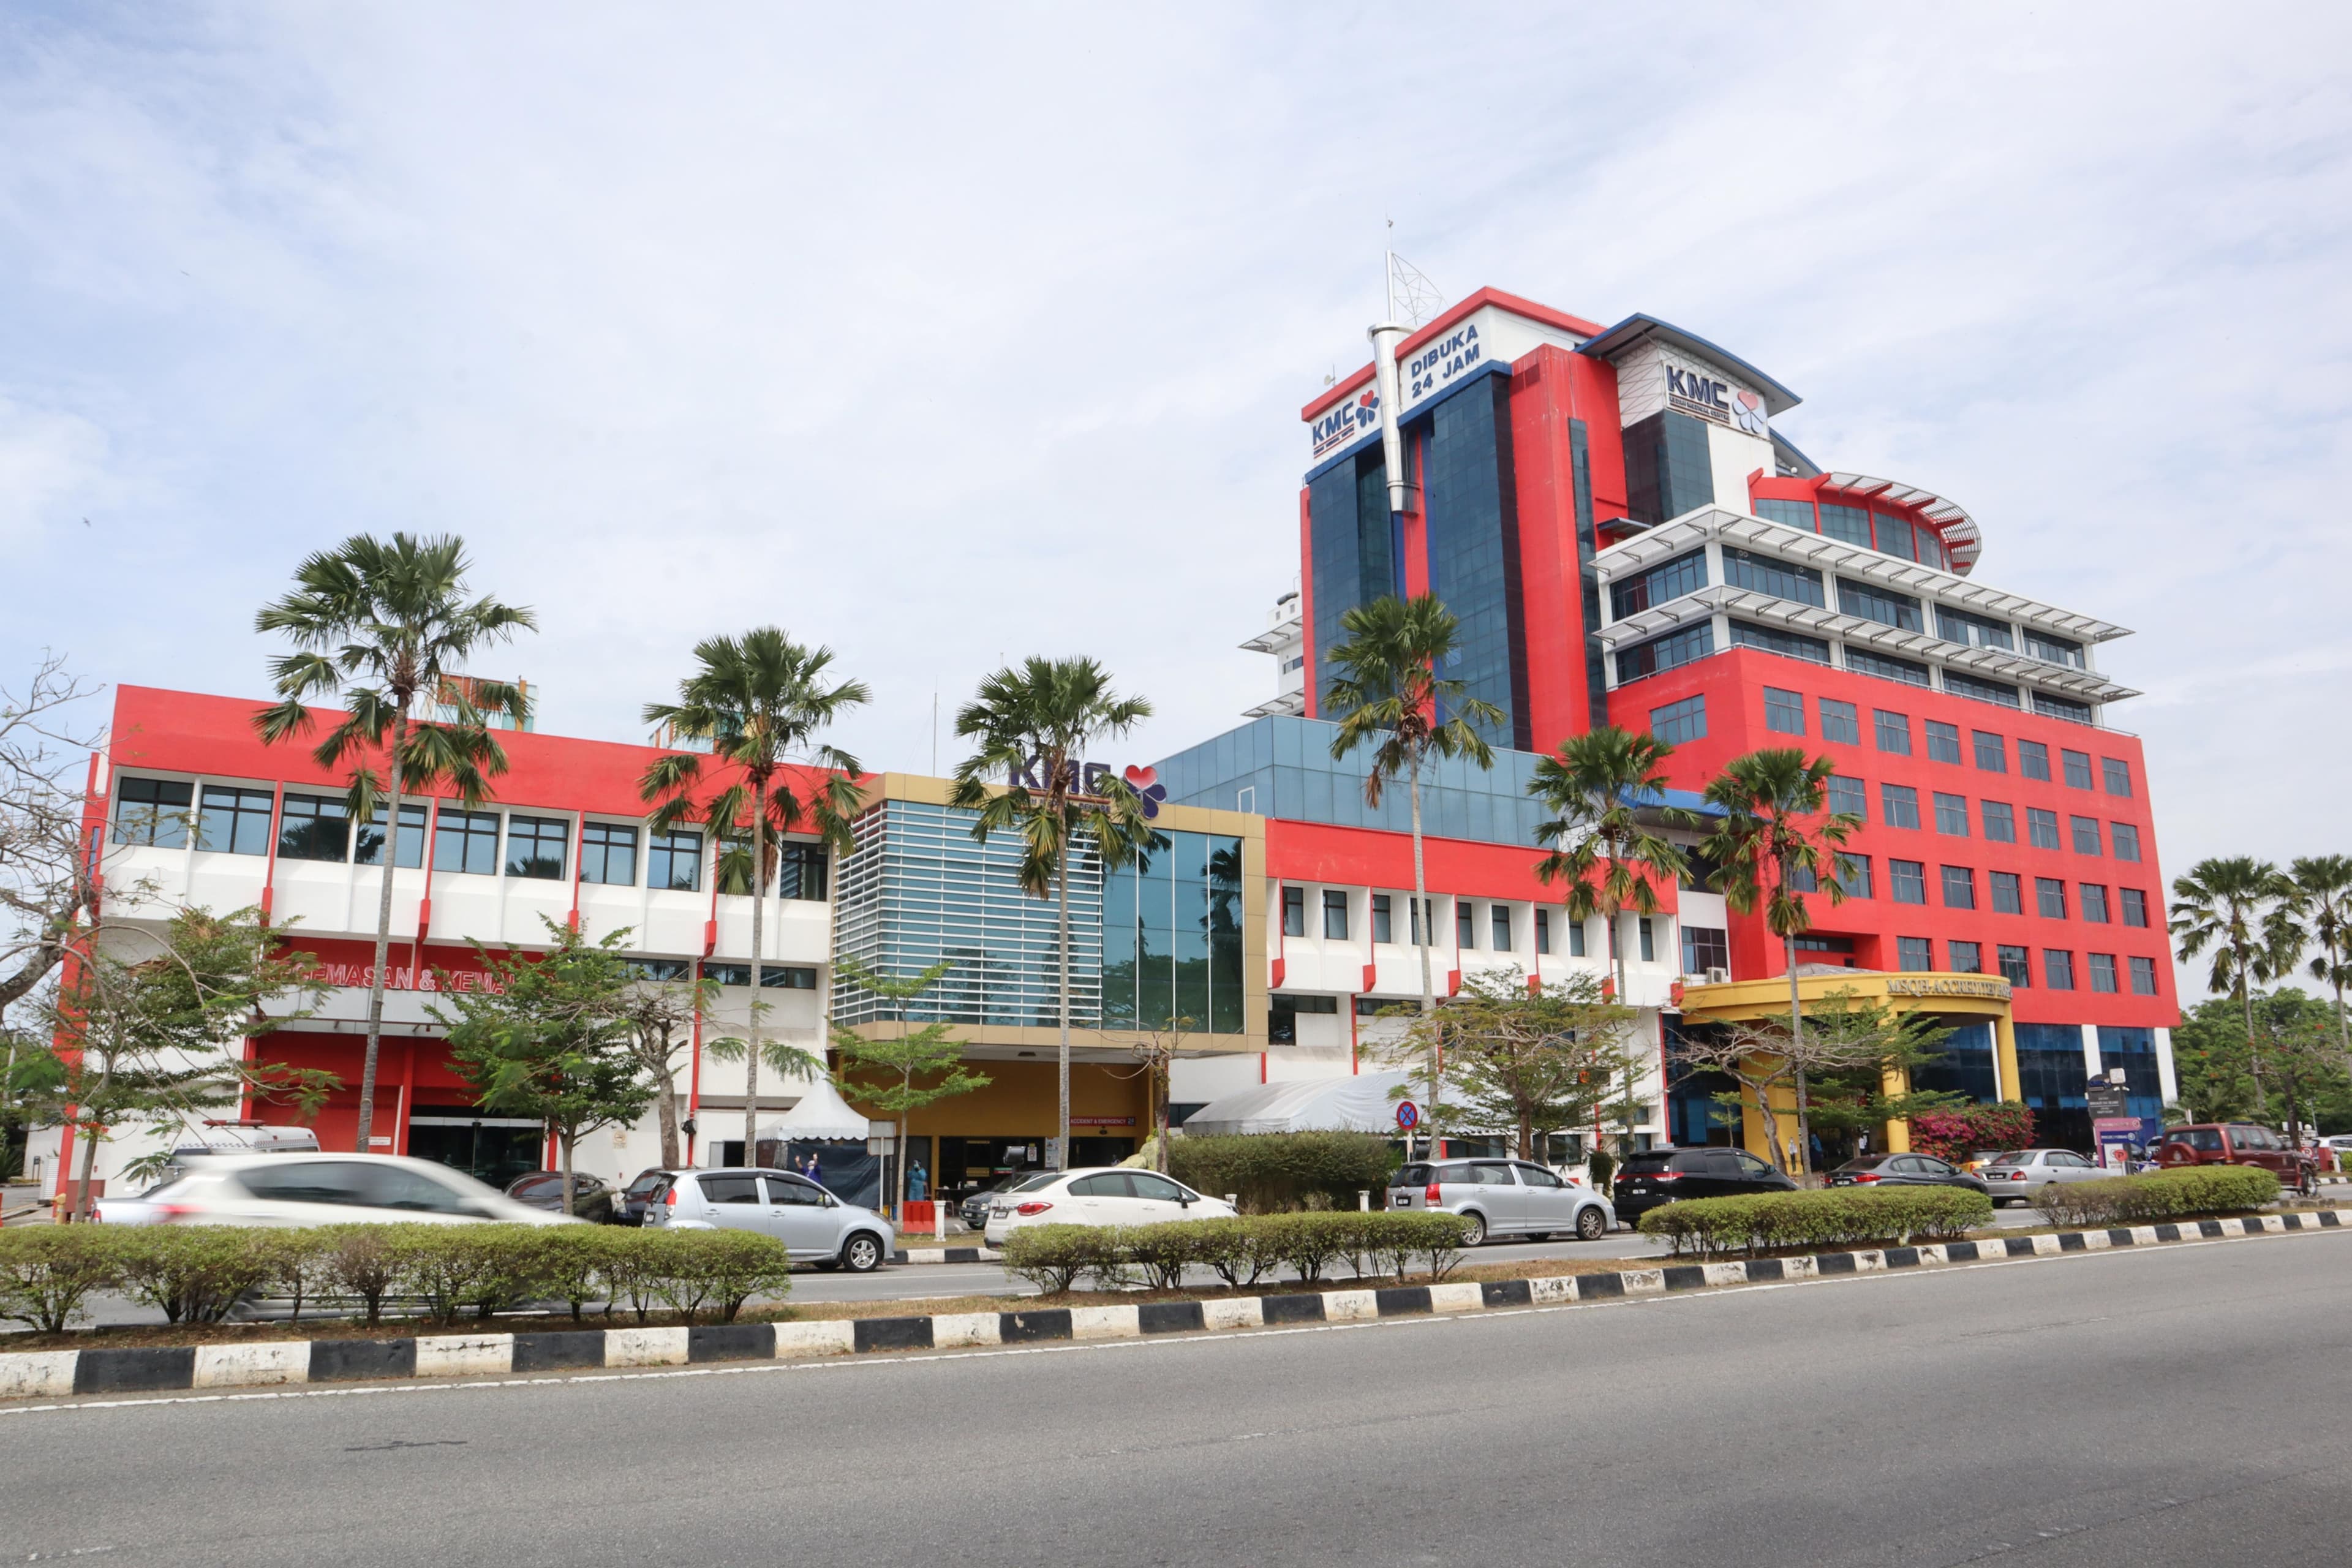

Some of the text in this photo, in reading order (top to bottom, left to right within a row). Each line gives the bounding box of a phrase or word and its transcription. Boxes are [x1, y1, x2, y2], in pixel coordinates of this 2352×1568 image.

[1411, 324, 1478, 377] DIBUKA
[1412, 344, 1479, 398] 24 JAM
[1666, 364, 1730, 410] KMC
[1313, 400, 1355, 446] KMC
[418, 969, 437, 992] &
